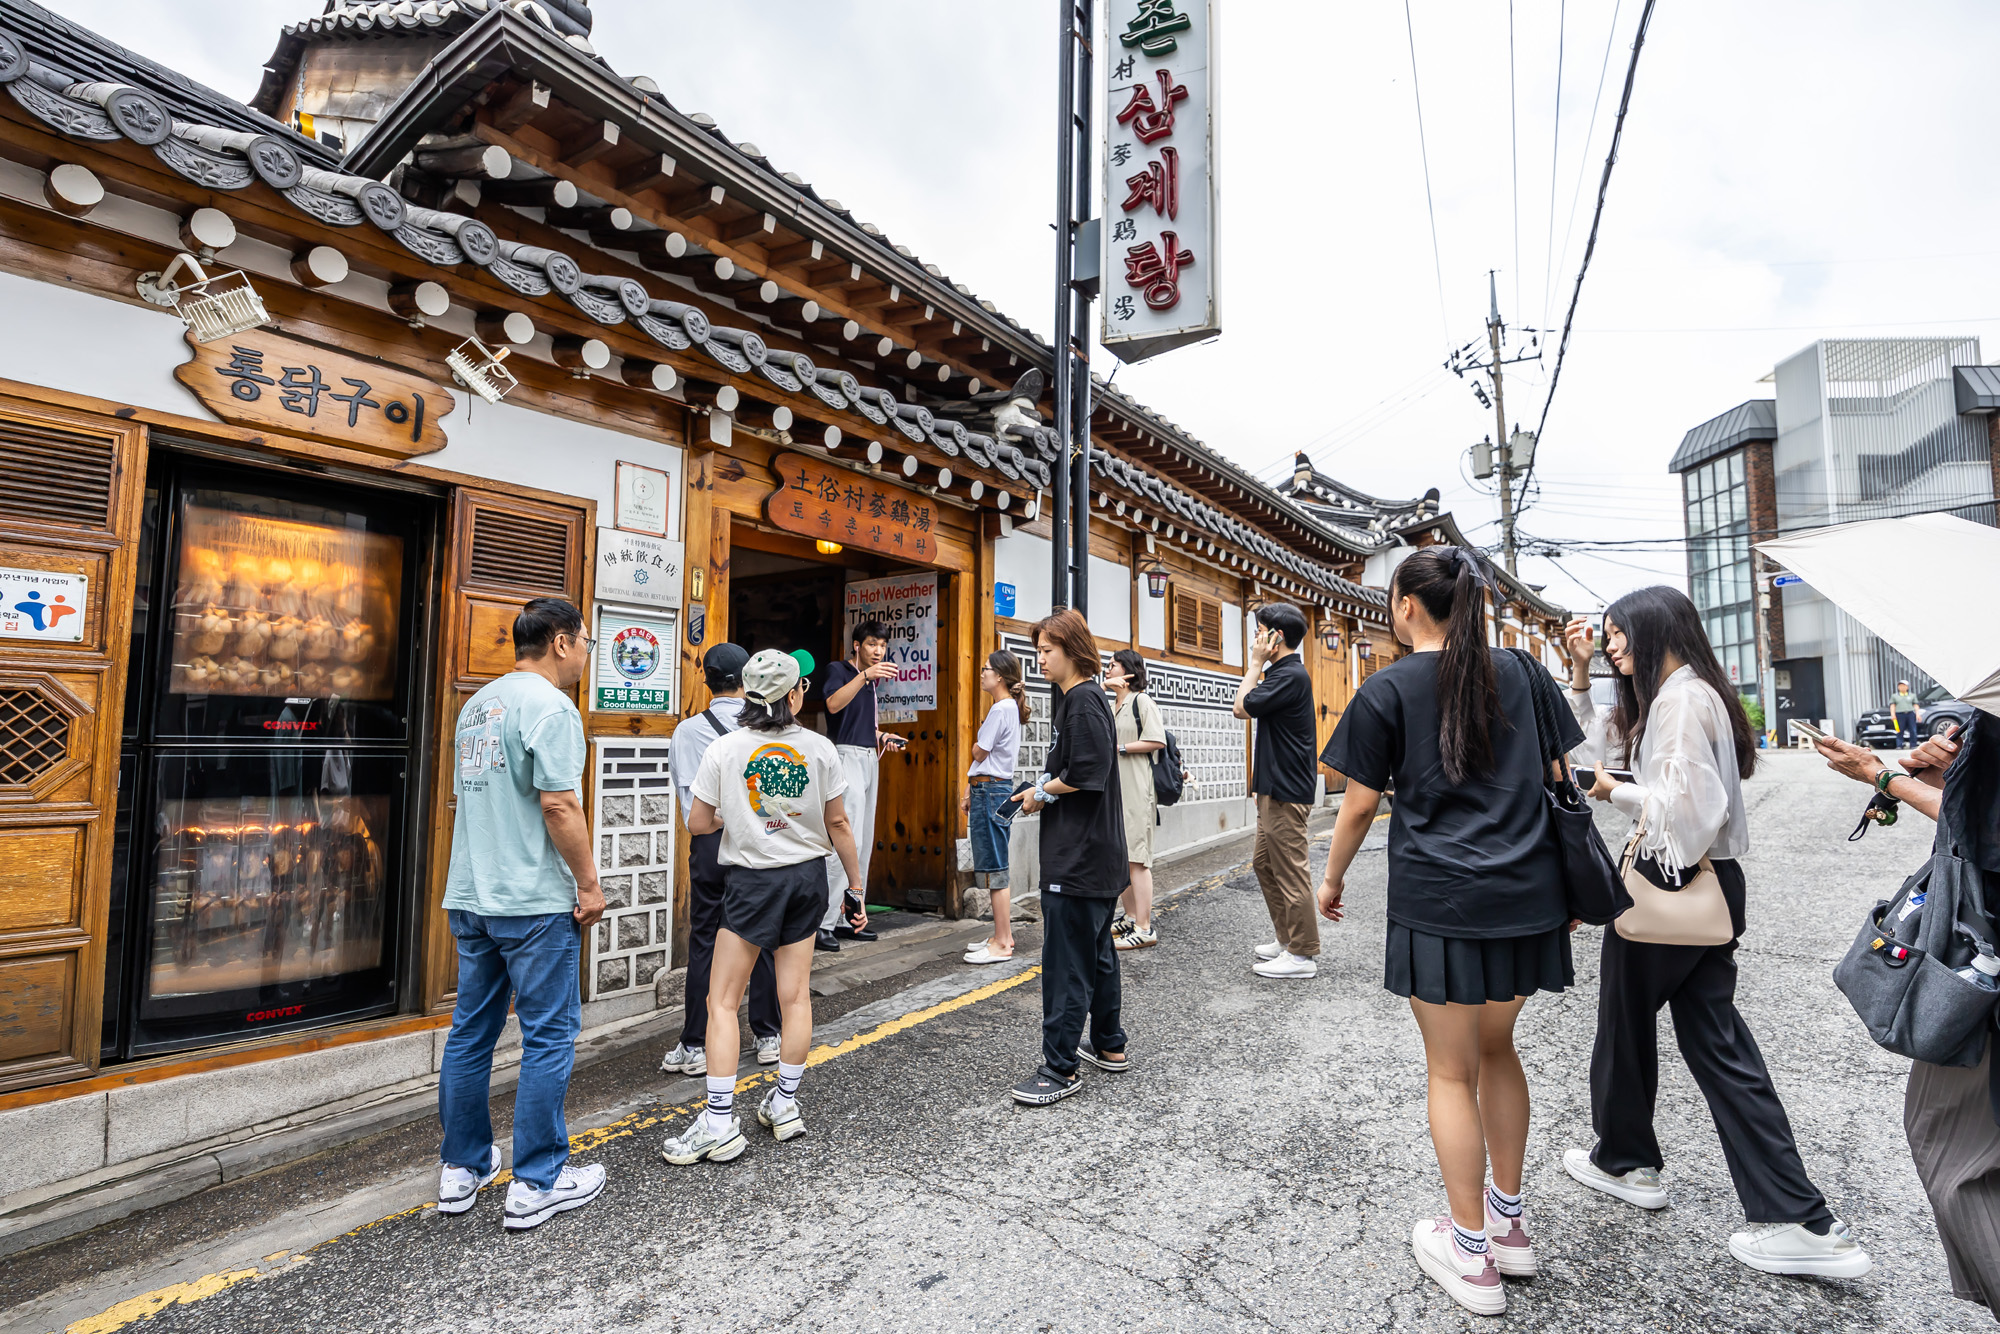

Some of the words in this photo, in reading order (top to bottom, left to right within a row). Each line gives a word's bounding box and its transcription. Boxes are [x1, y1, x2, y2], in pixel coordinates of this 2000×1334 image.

[1116, 69, 1195, 311] 삼계탕
[215, 345, 425, 443] 통닭구이
[789, 501, 927, 555] 토속촌삼계탕
[0, 573, 39, 583] 주년기념
[42, 577, 69, 586] 사업회
[601, 585, 630, 596] TRADITIONAL
[632, 590, 650, 599] KOREAN
[650, 593, 677, 603] RESTAURANT
[847, 590, 857, 605] In
[859, 588, 881, 604] Hot
[883, 582, 934, 601] Weather
[0, 612, 19, 620] 학교
[849, 606, 903, 625] Thanks
[906, 603, 932, 620] For
[899, 646, 929, 663] You
[603, 688, 665, 702] 모범음식점
[603, 701, 625, 709] Good
[626, 701, 664, 710] Restaurant
[263, 721, 318, 730] CONVEX
[766, 819, 788, 829] nike
[246, 1004, 303, 1022] CONVEX
[1038, 1091, 1062, 1103] crocs
